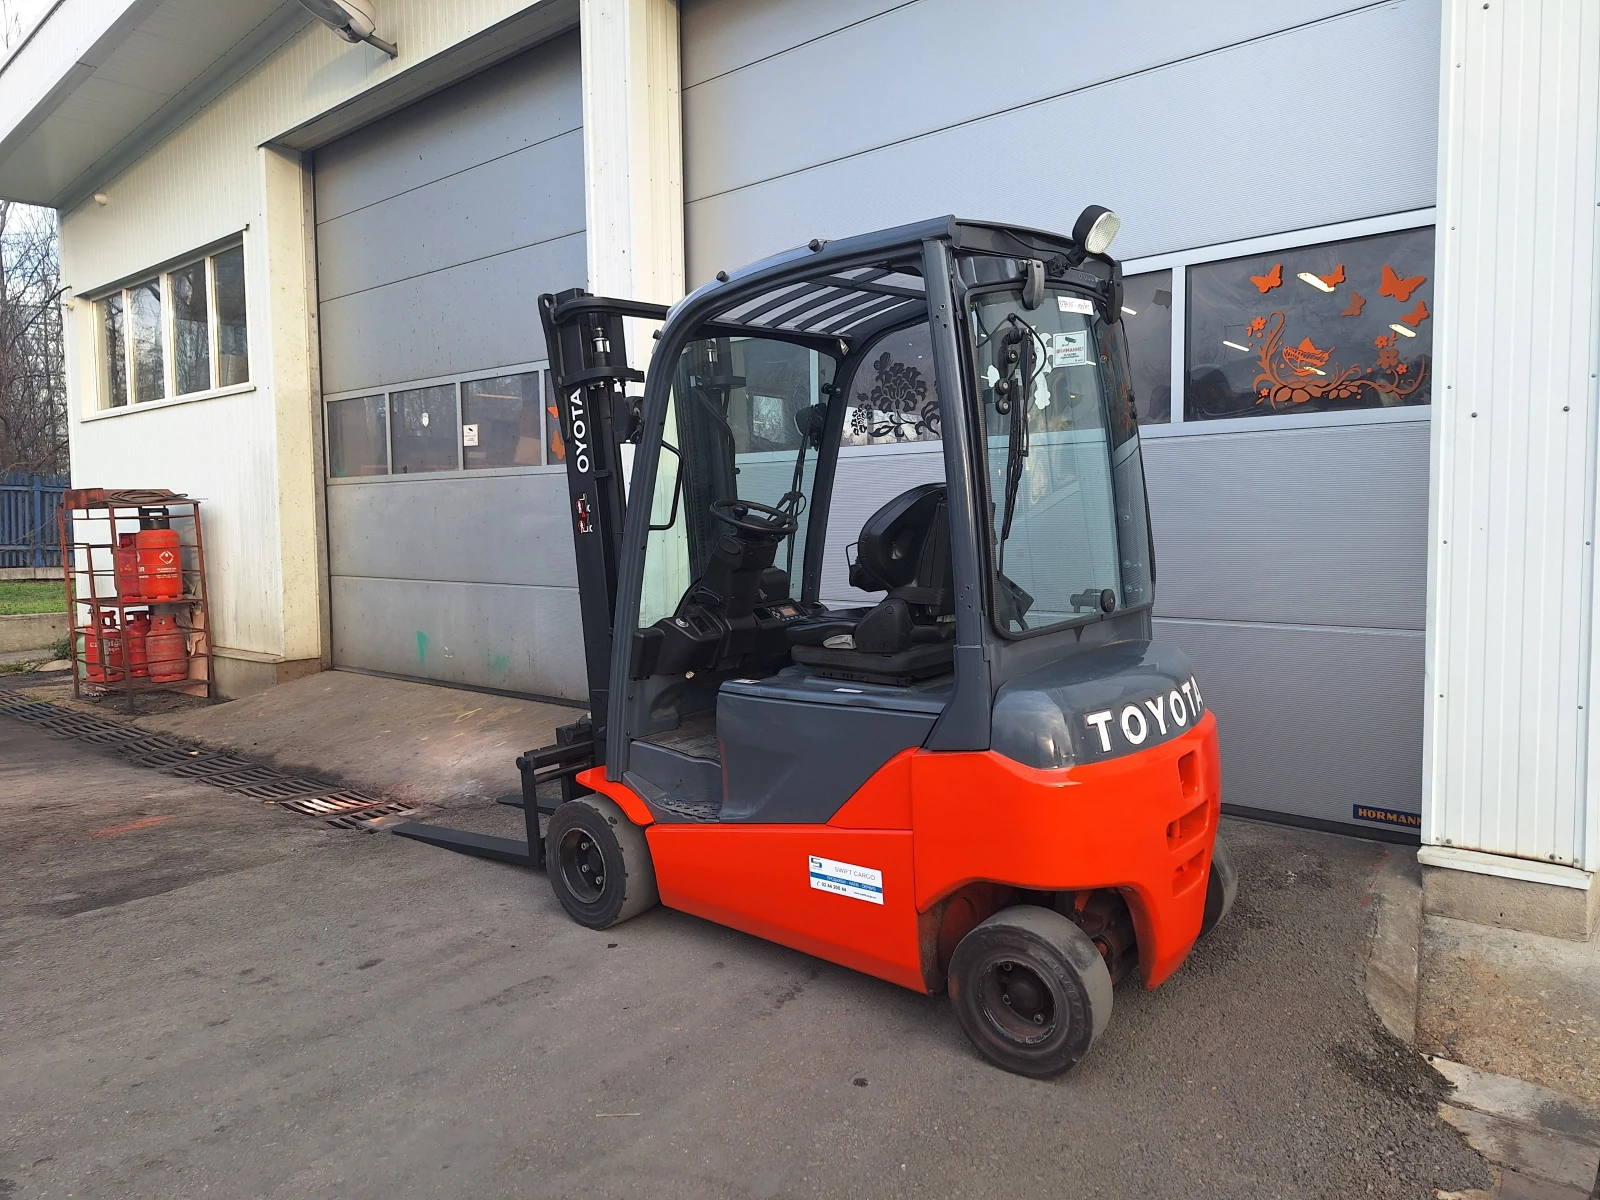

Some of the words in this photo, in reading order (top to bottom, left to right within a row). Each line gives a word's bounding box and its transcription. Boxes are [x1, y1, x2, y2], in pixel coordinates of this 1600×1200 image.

[1086, 675, 1204, 753] TOYOTA
[834, 866, 852, 876] SWIFT
[853, 870, 876, 881] CARGO
